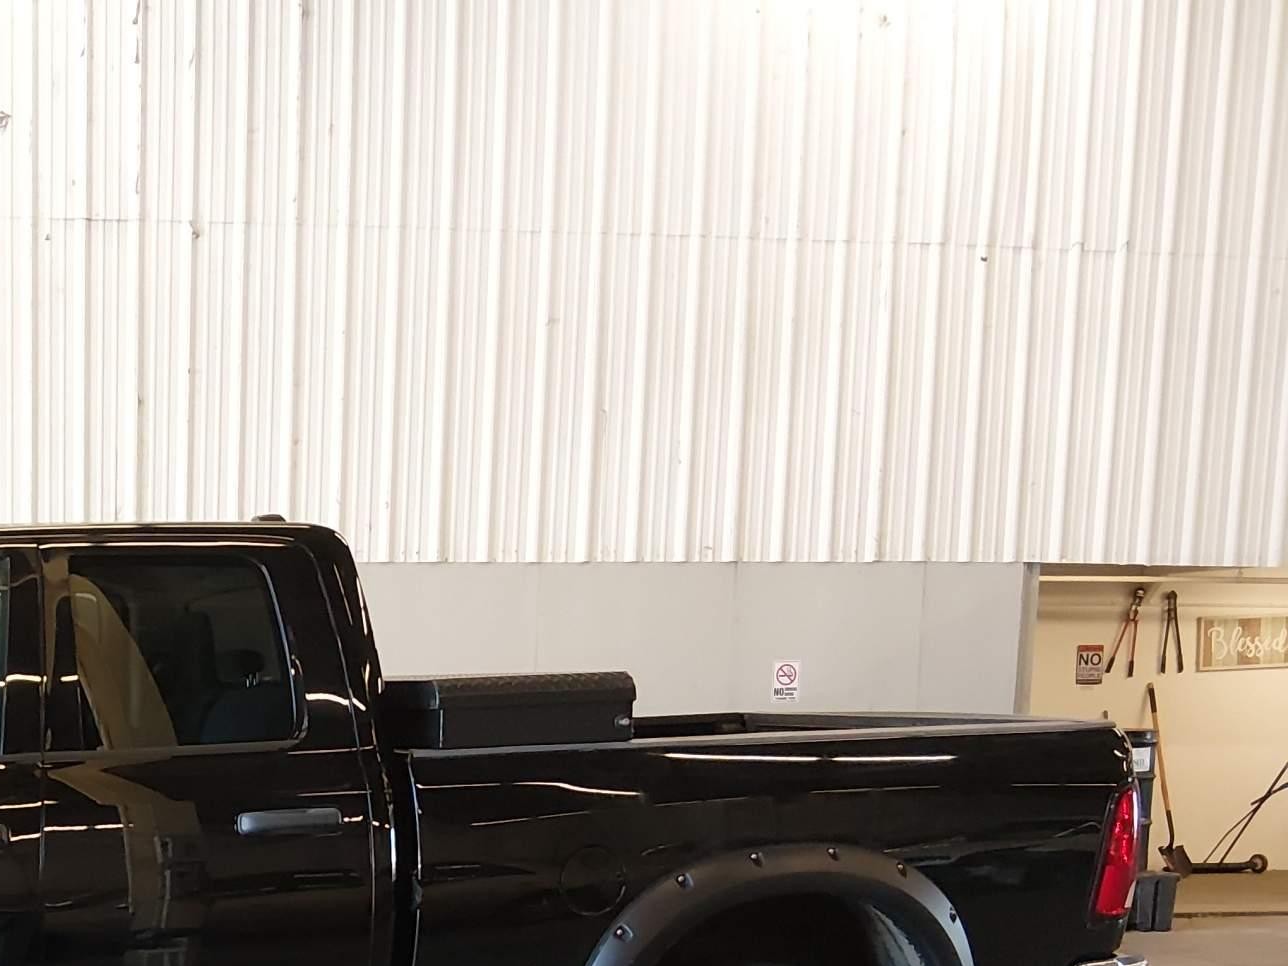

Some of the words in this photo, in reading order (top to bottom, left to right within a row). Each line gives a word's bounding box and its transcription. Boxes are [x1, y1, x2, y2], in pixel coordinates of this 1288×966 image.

[1208, 626, 1288, 660] Blessed
[1078, 653, 1102, 666] NO
[774, 688, 784, 696] NO
